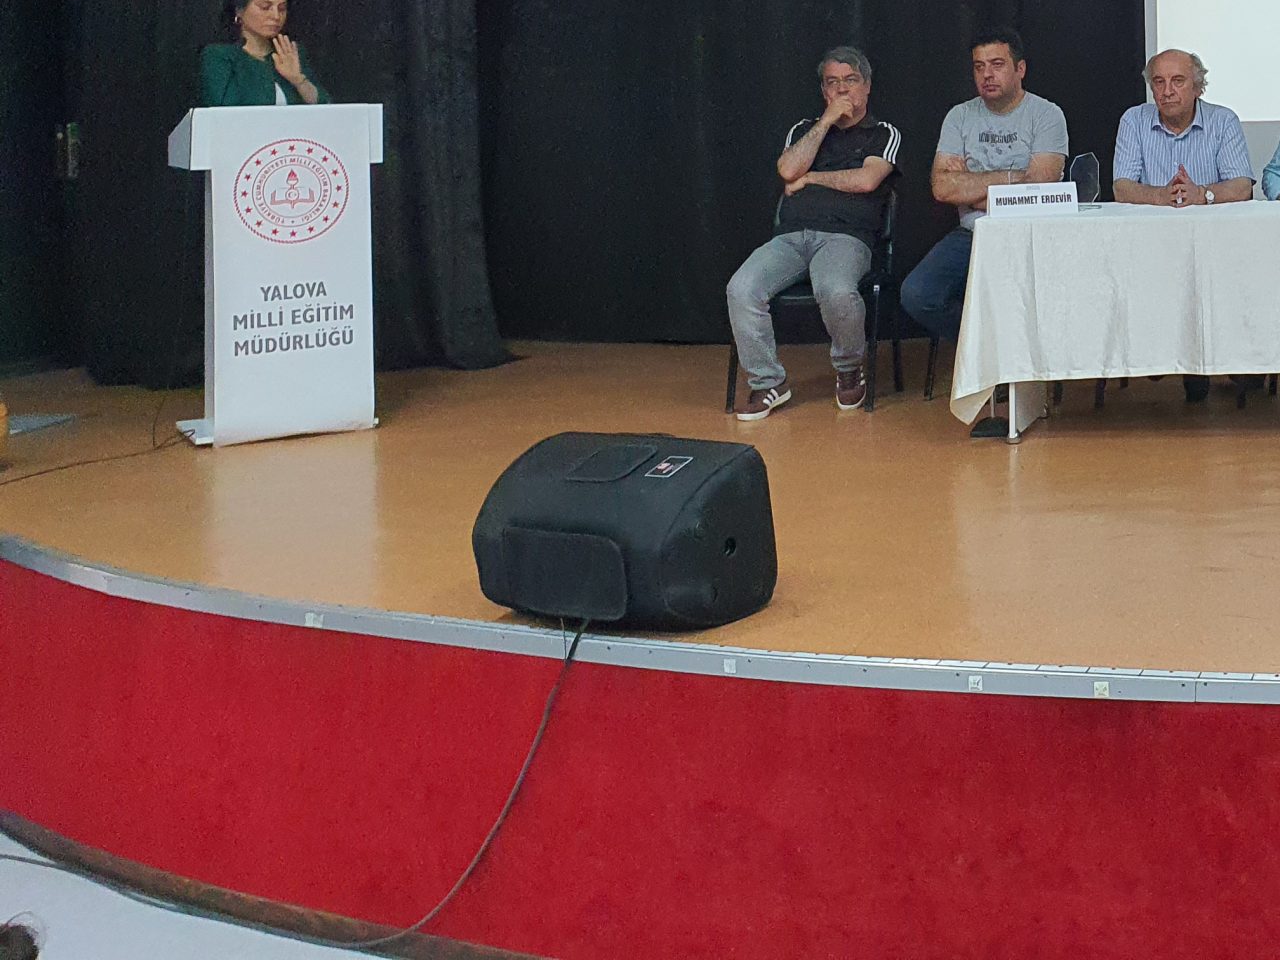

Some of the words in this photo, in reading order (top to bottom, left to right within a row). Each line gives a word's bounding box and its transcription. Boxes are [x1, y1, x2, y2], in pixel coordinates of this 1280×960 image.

[995, 195, 1038, 206] MUHAMMET
[1041, 192, 1072, 204] ERDEVİR
[260, 281, 327, 302] YALOVA
[233, 306, 283, 331] MİLLİ
[291, 301, 354, 325] EĞİTİM
[234, 325, 354, 357] MÜDÜRLÜĞÜ
